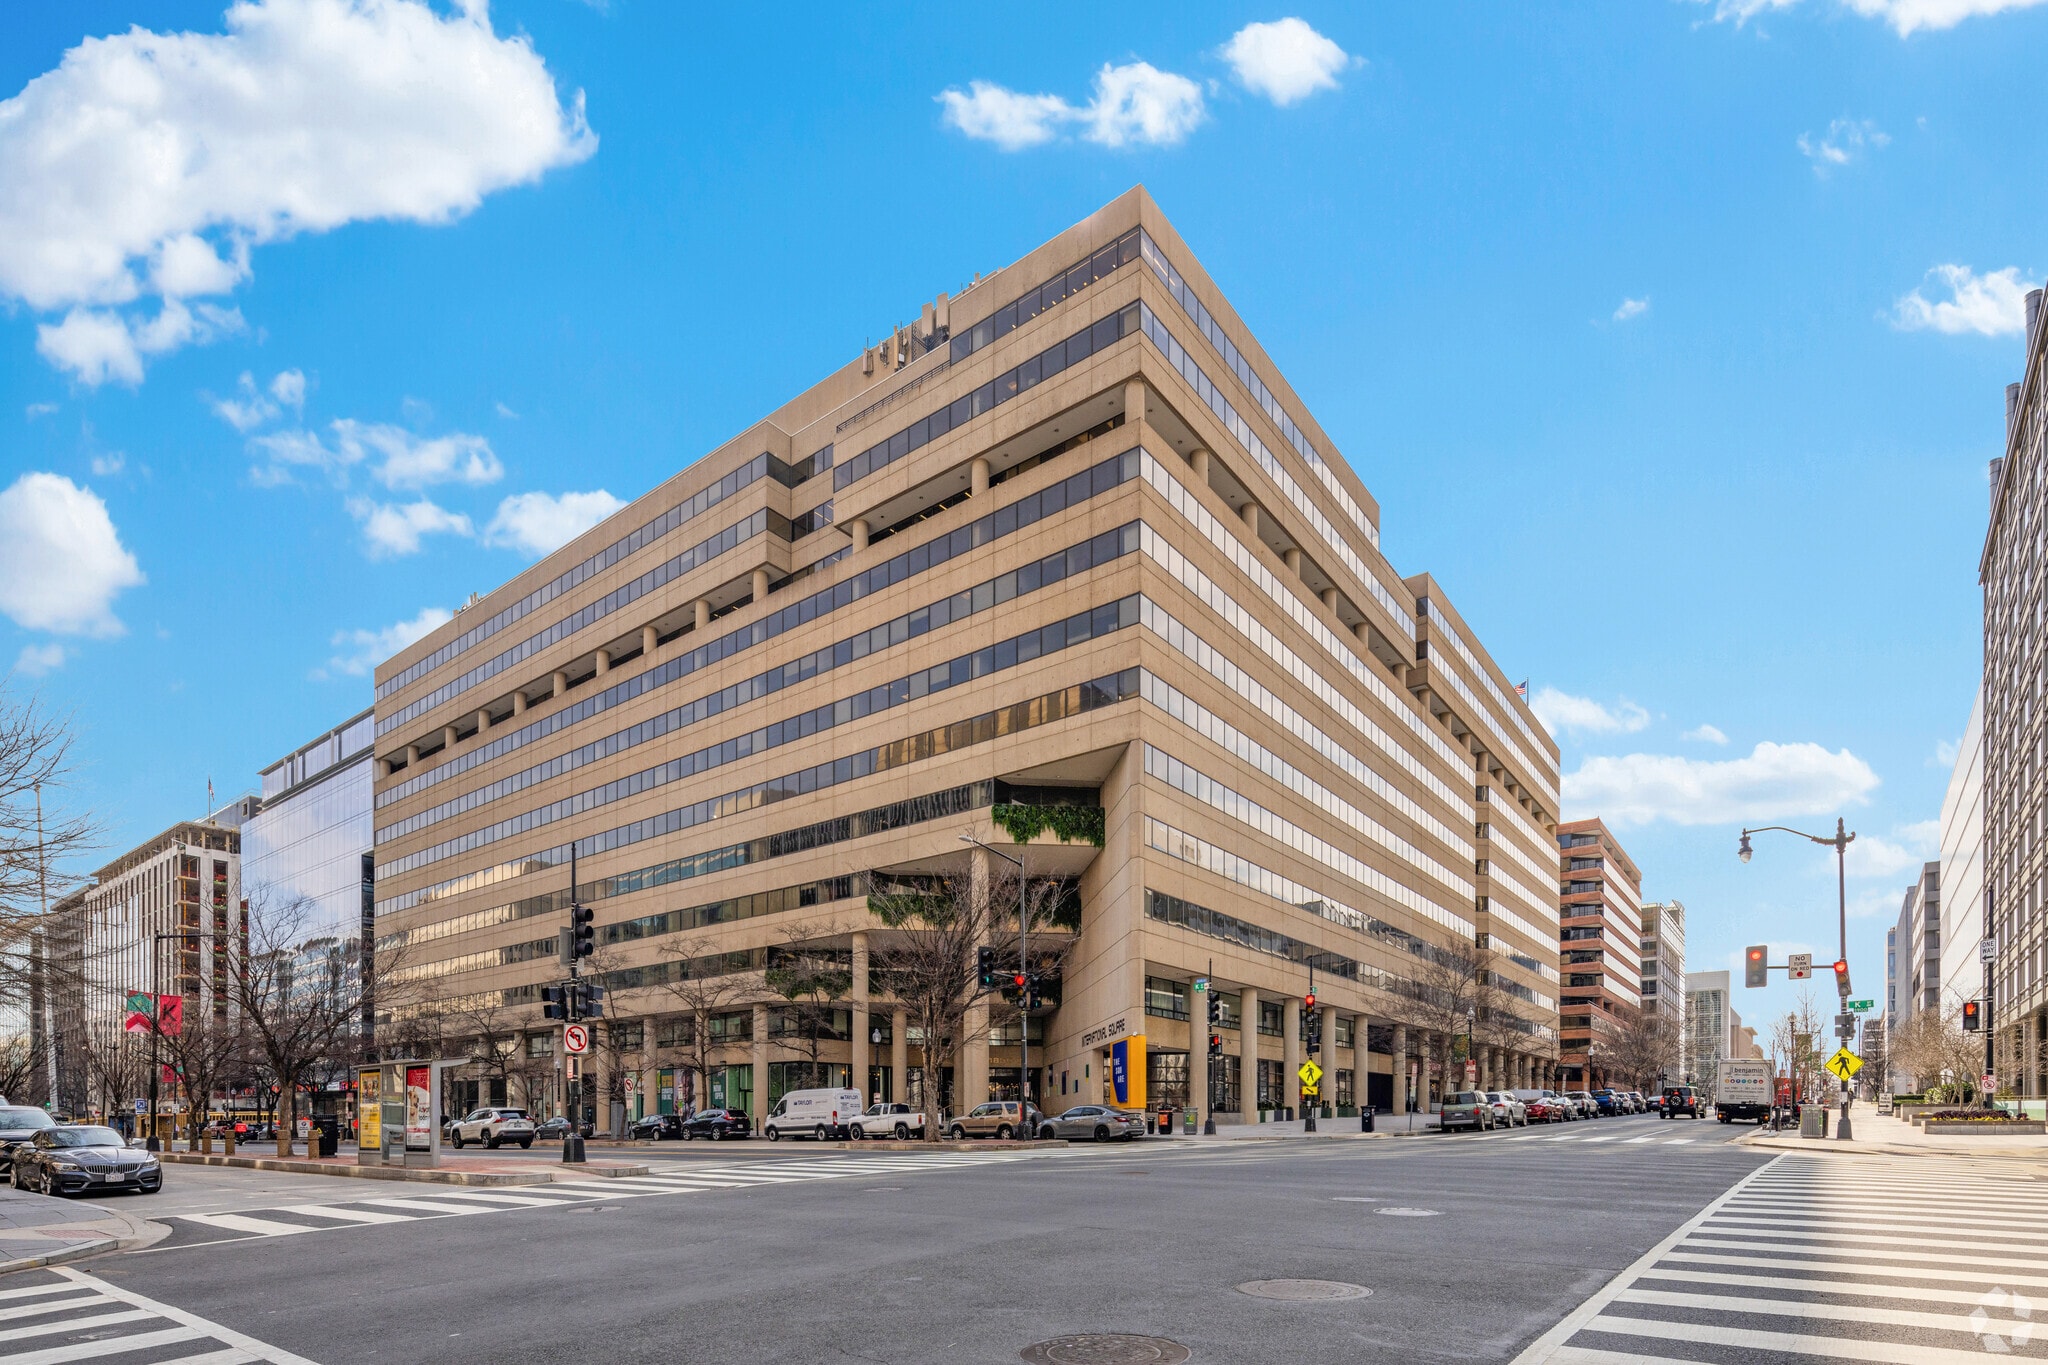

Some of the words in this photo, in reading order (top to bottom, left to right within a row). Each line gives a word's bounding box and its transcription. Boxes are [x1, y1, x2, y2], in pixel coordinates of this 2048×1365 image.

[162, 1004, 176, 1021] K
[1081, 1026, 1107, 1047] INTERNATIONAL
[1108, 1018, 1125, 1037] SQUARE
